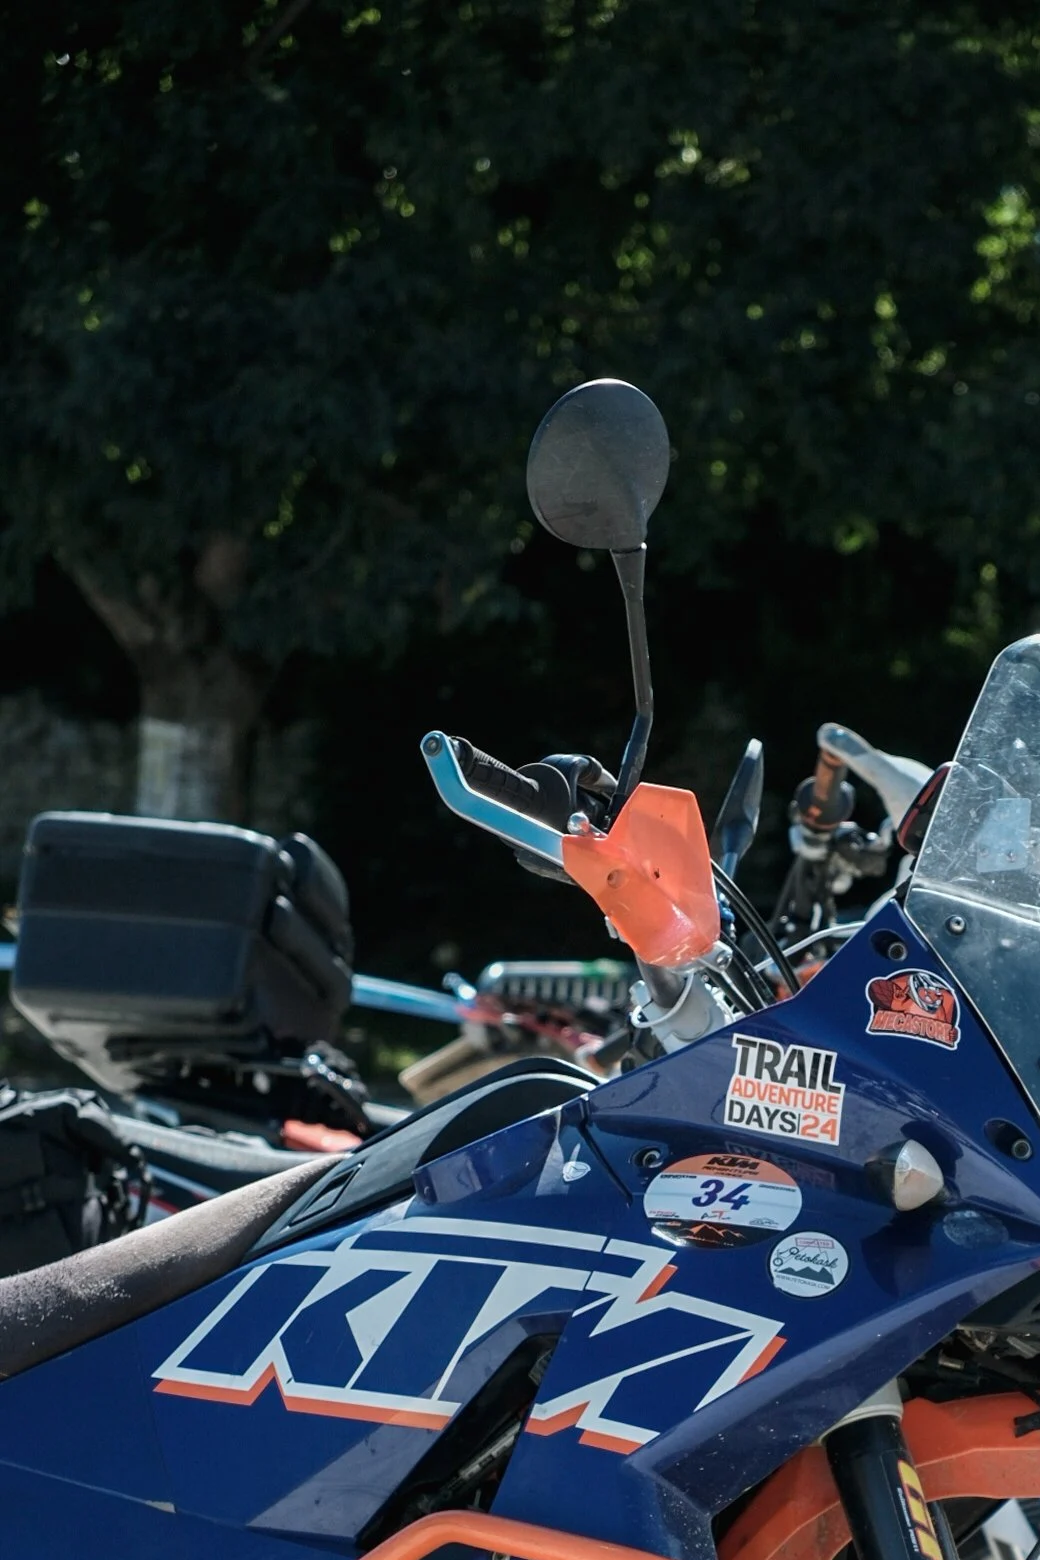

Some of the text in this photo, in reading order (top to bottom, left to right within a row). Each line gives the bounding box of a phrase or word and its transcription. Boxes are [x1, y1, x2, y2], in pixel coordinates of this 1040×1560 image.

[735, 1037, 842, 1095] TRAIL
[731, 1077, 840, 1115] ADVENTURE
[727, 1099, 838, 1142] DAYS 24
[707, 1155, 760, 1170] KTM
[692, 1179, 752, 1211] 34
[151, 1216, 787, 1455] KTM
